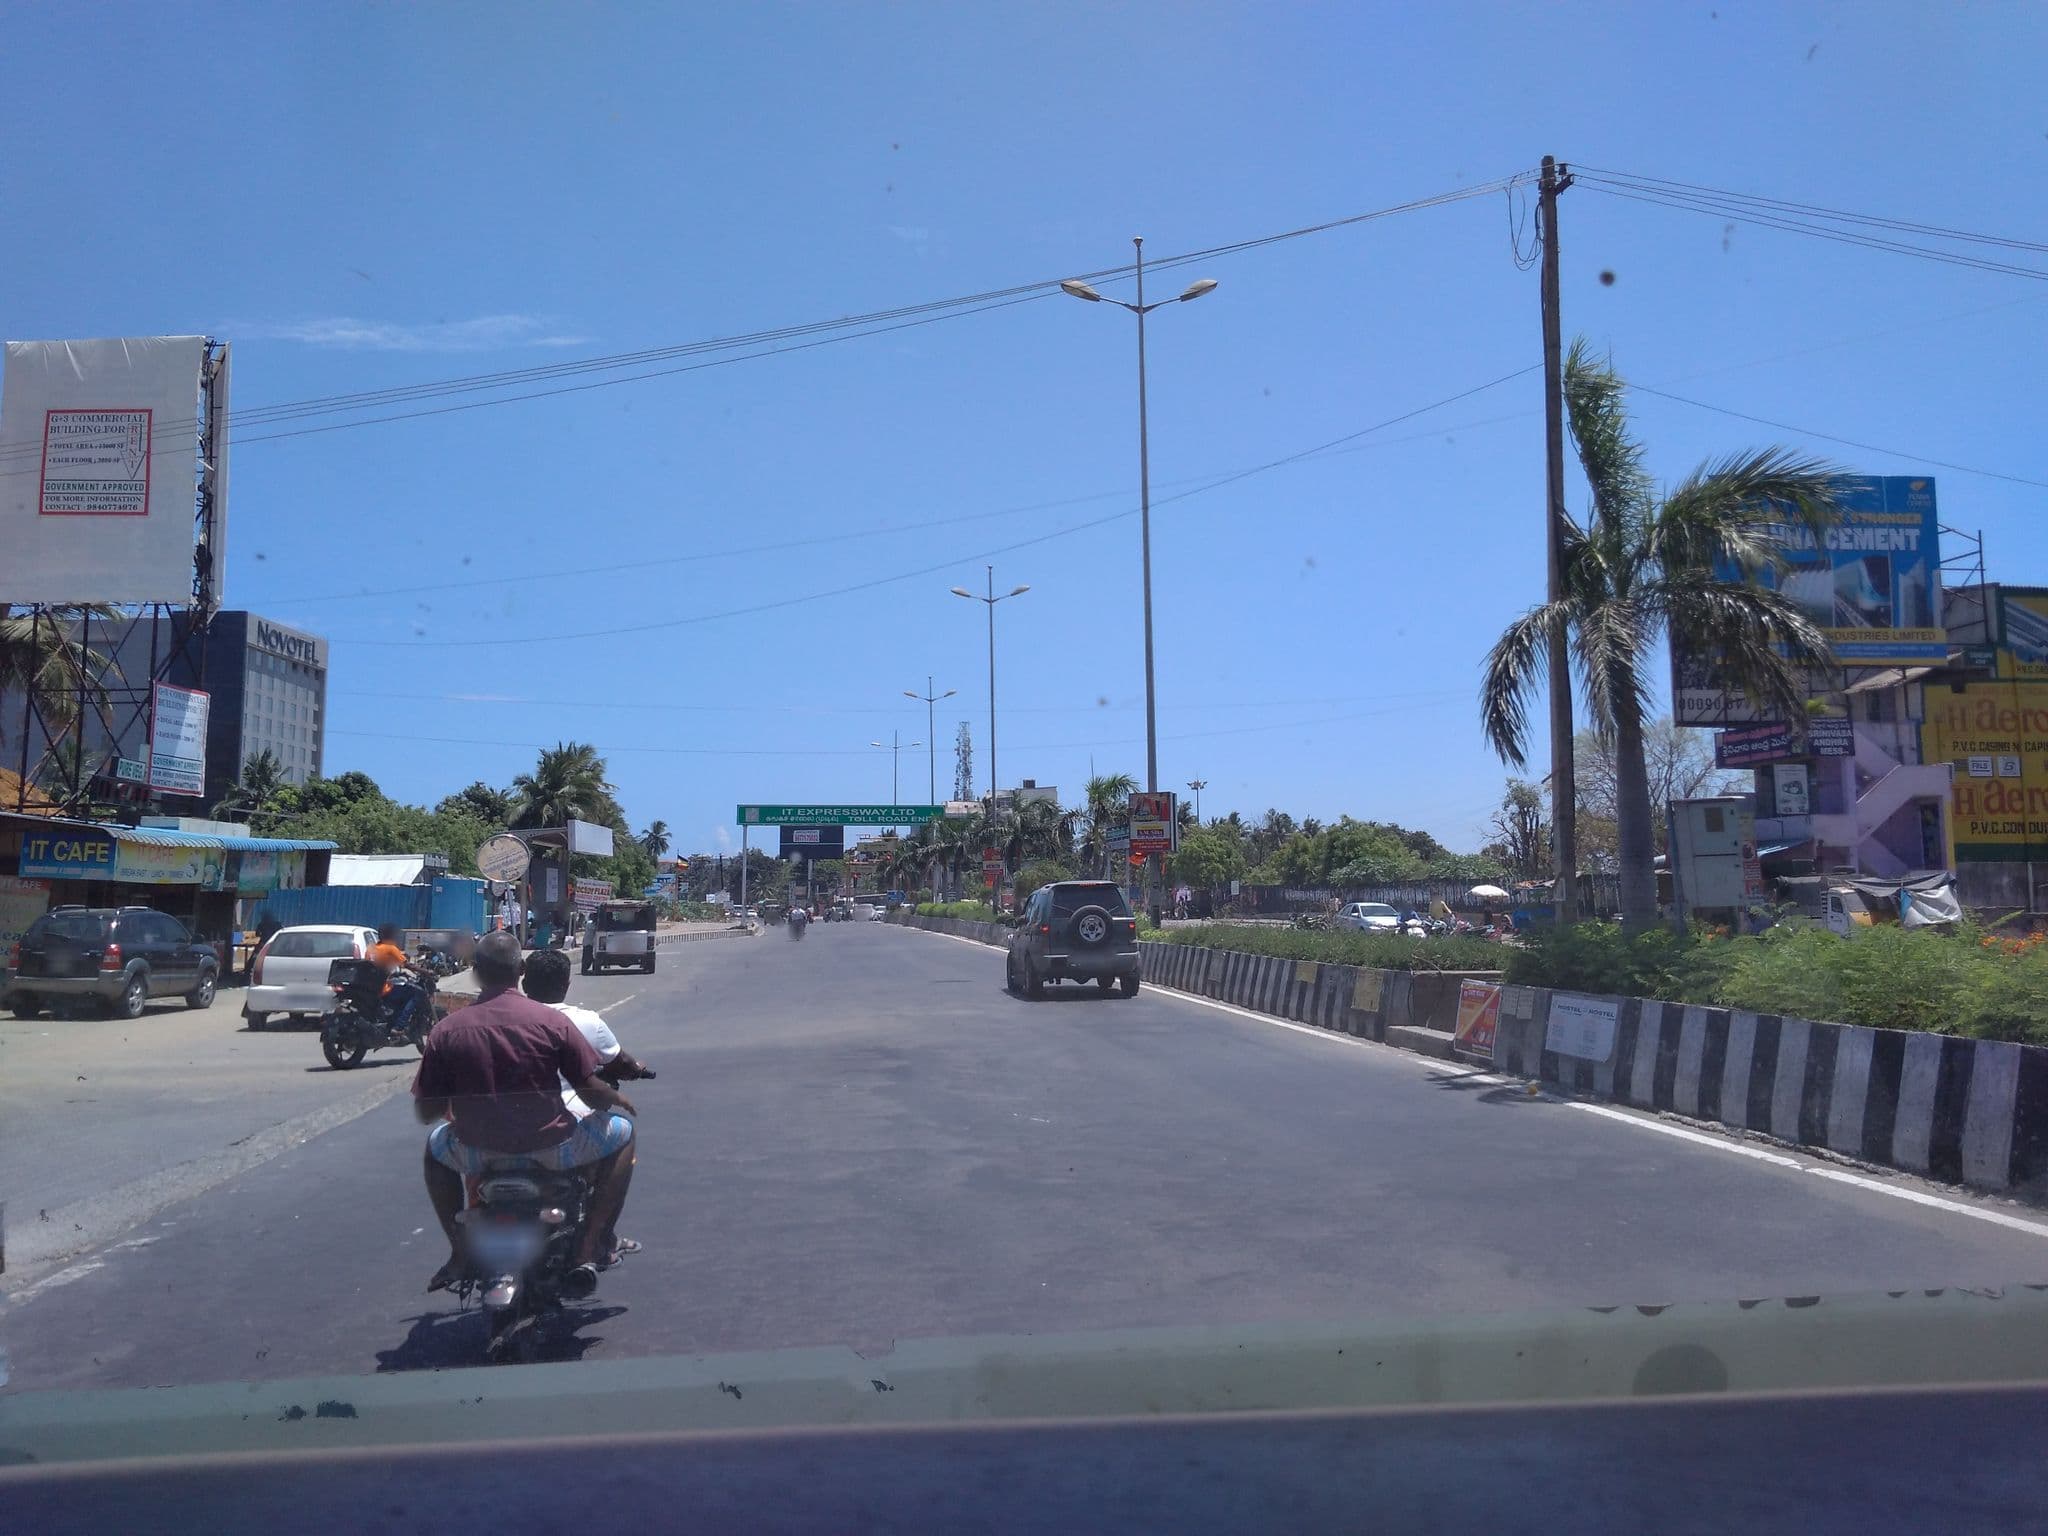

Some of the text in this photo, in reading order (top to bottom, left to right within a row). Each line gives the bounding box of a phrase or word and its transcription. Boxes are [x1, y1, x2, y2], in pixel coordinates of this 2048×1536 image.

[72, 414, 145, 423] COMMERCIAL
[50, 425, 126, 434] BUILDING FOR
[45, 482, 145, 491] GOVERNMENT APPROVED
[1824, 527, 1921, 551] CEMENT
[1893, 631, 1936, 641] LIMITED
[257, 620, 320, 664] NOVOTEL
[1813, 738, 1849, 746] ANDHRA
[782, 808, 915, 816] IT EXPRESSWAY LTD
[30, 840, 110, 863] IT CAFE
[1557, 1004, 1615, 1018] HOSTEL HOSTEL
